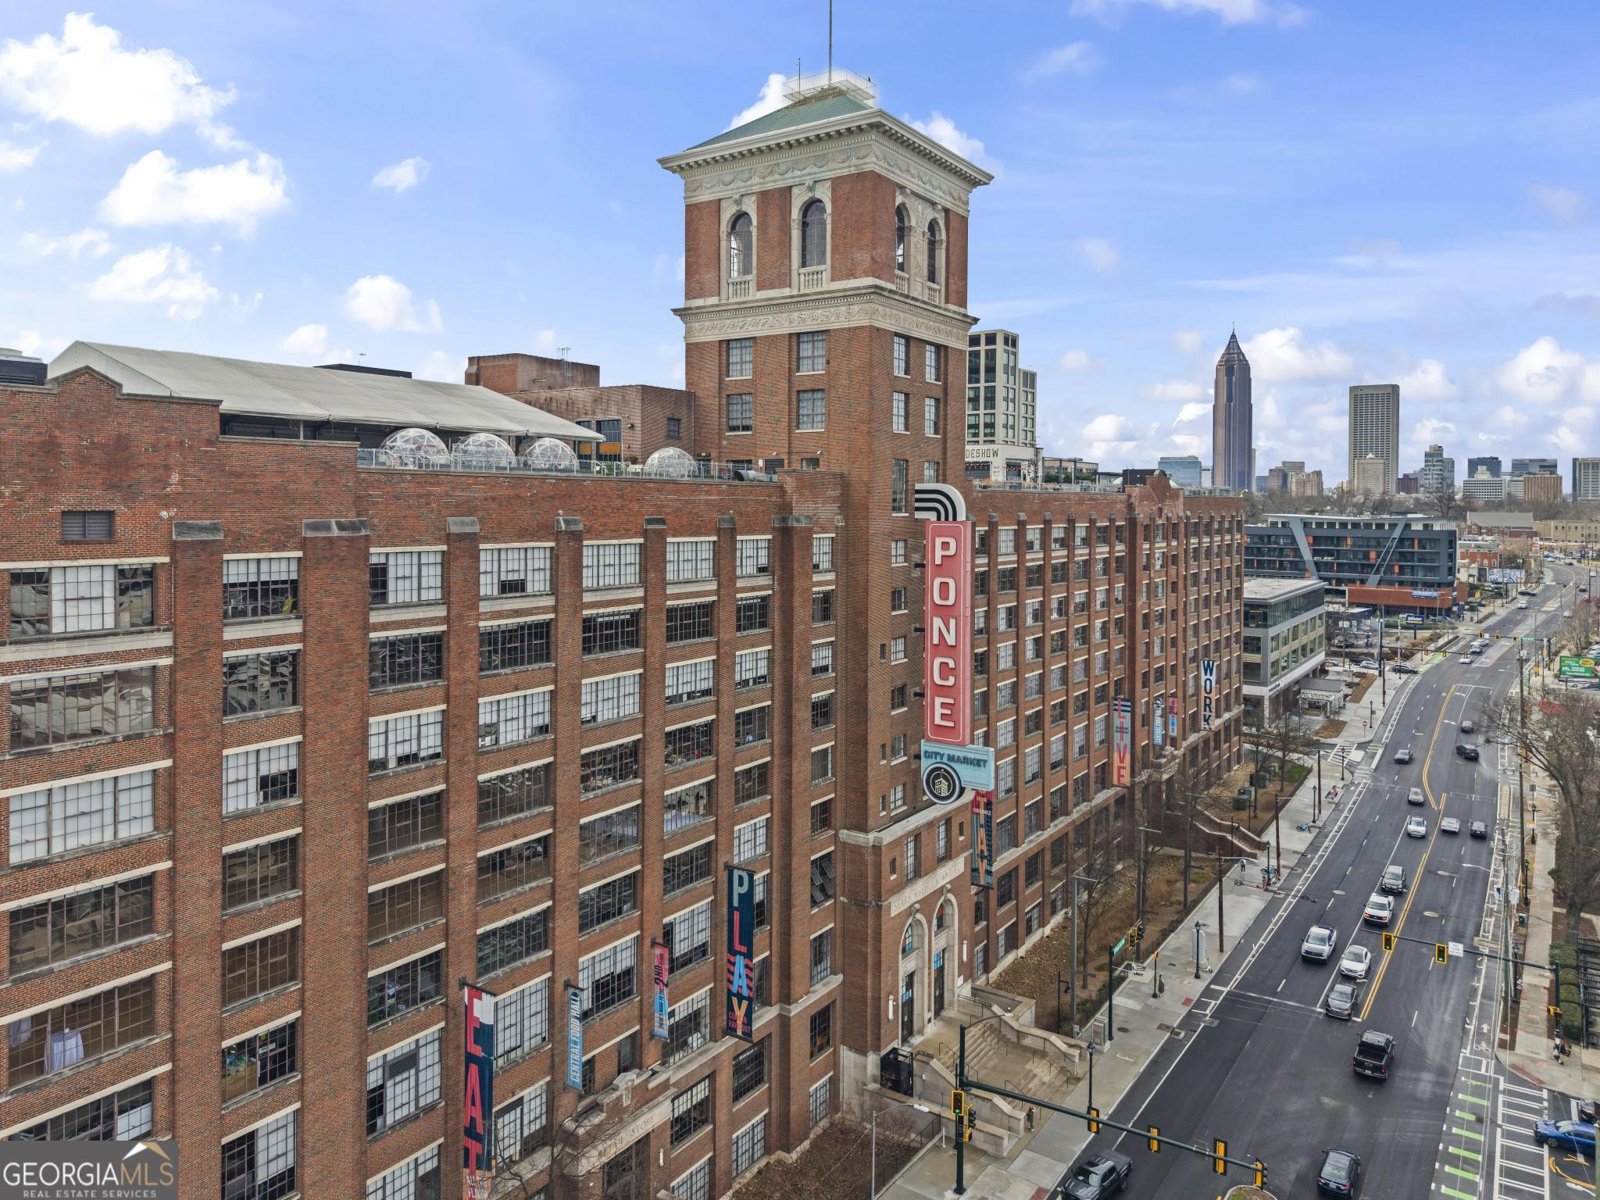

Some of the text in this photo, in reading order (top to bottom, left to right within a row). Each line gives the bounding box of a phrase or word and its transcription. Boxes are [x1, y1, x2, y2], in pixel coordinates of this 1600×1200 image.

[932, 536, 957, 727] PONCE
[1202, 660, 1215, 731] WORK
[923, 750, 988, 768] CITY MARKET
[1116, 696, 1127, 785] LIVE
[654, 964, 669, 988] 2ND
[732, 869, 748, 1036] PLAY
[464, 986, 483, 1176] EAT
[571, 994, 579, 1082] CENTRAL FOOD HALL
